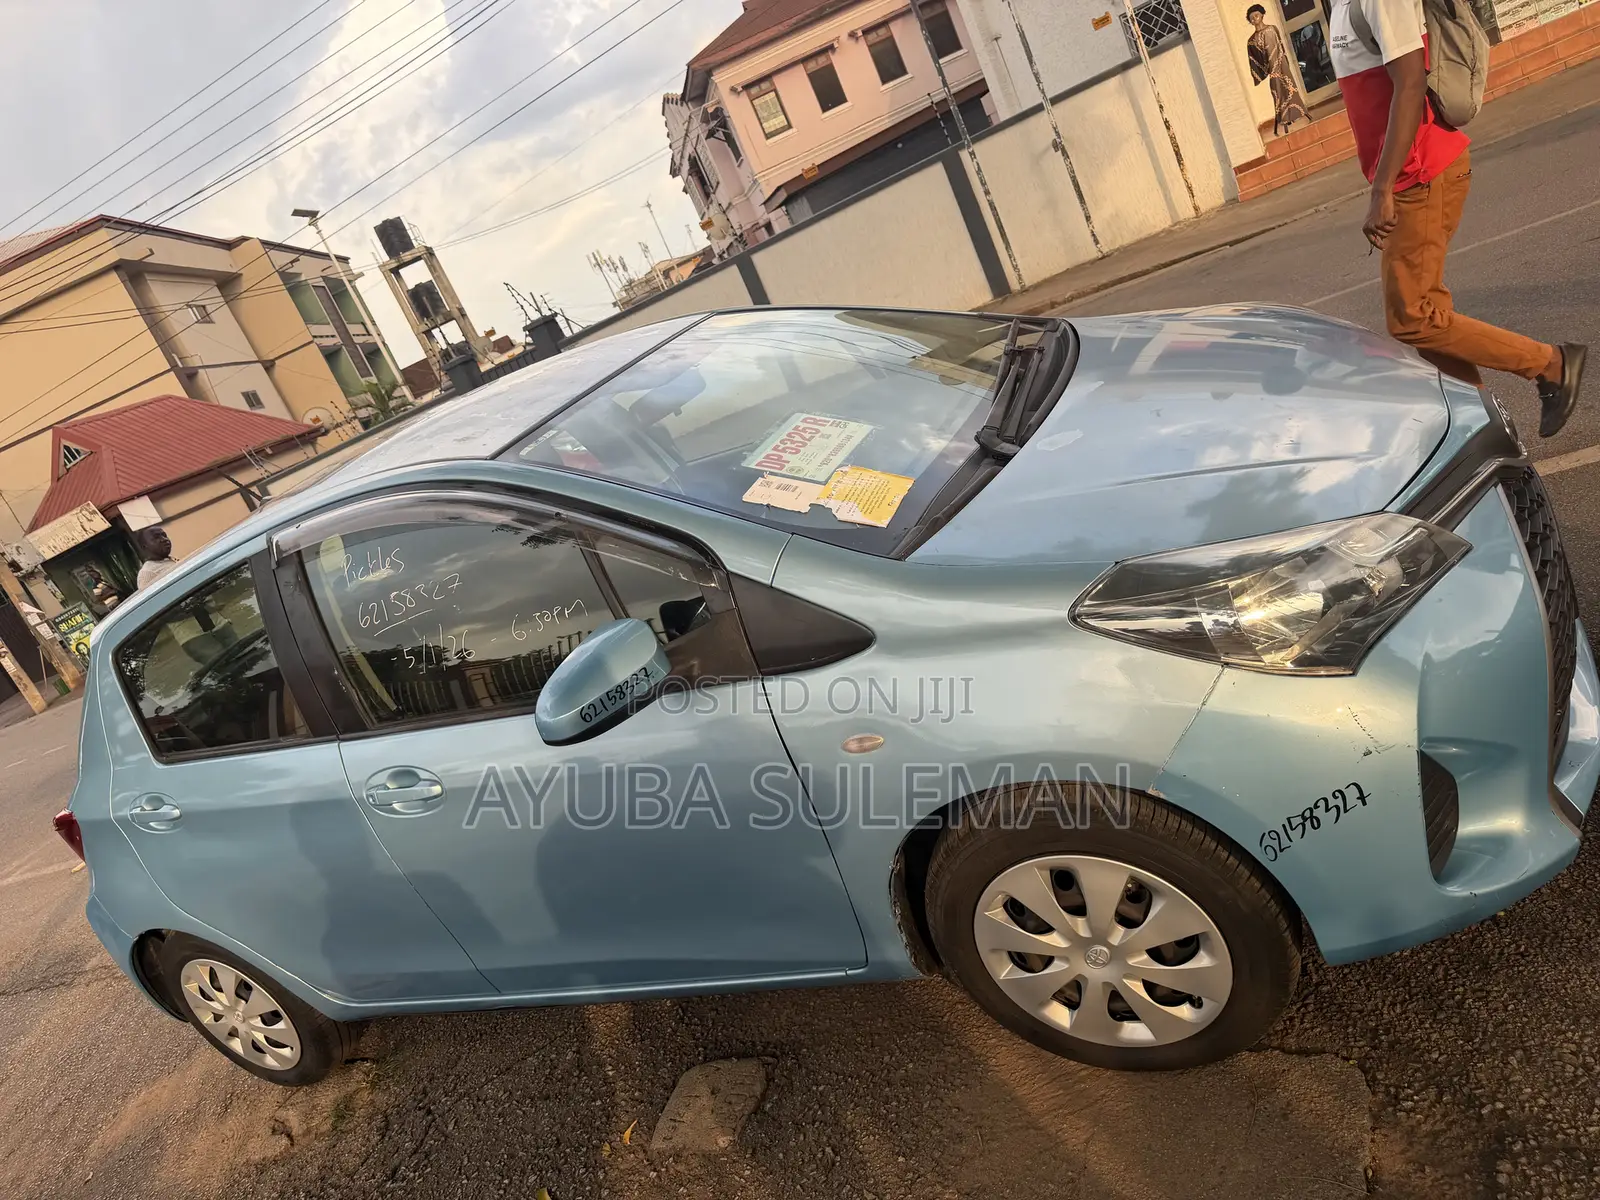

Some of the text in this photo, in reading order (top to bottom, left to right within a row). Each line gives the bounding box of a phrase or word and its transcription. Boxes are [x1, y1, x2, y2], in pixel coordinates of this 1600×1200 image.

[800, 416, 831, 427] R
[772, 425, 821, 455] 5325
[754, 453, 791, 471] DP
[579, 666, 654, 723] 62158327
[1258, 781, 1372, 862] 62158327
